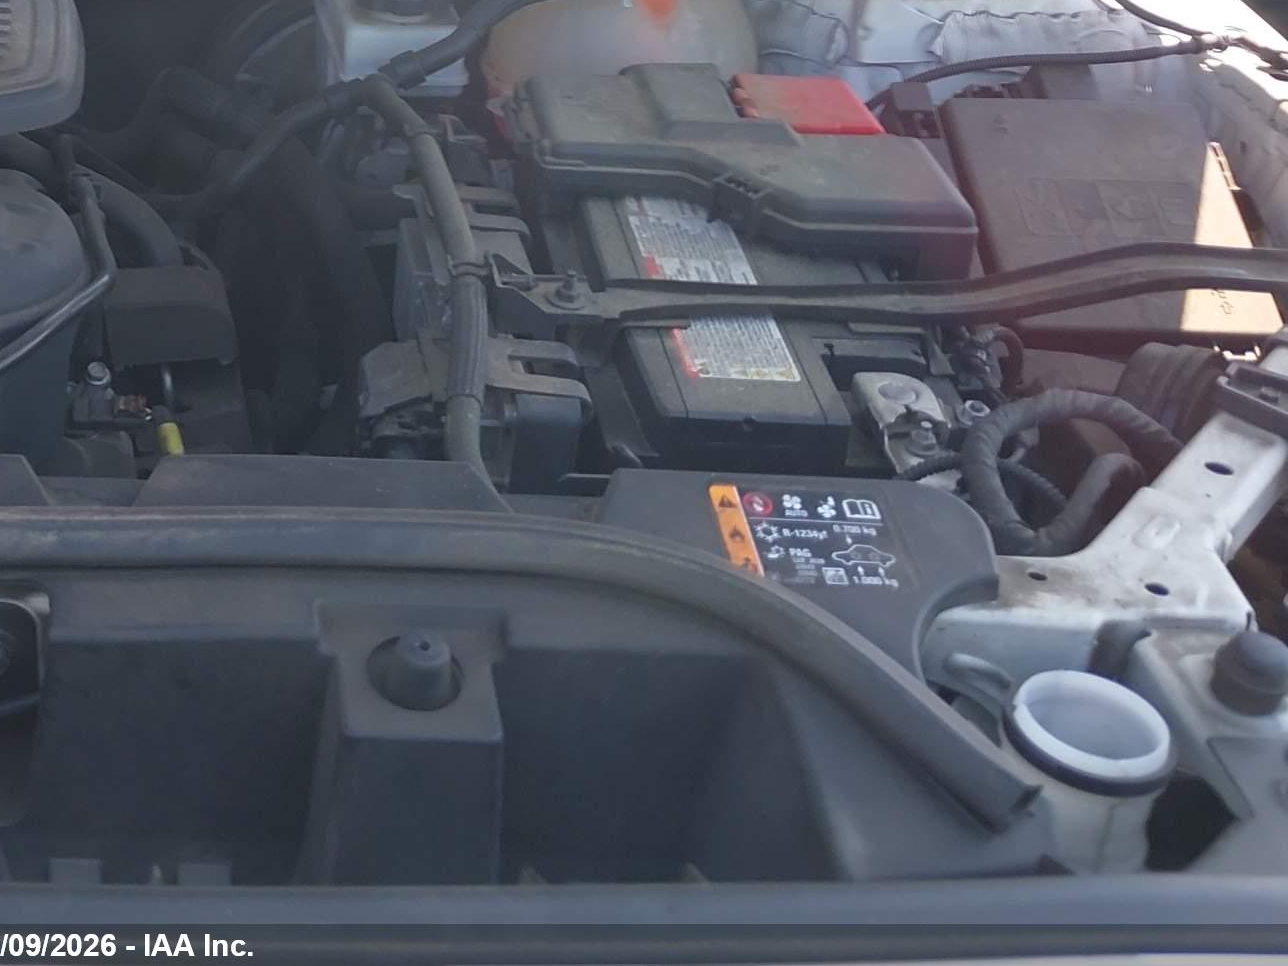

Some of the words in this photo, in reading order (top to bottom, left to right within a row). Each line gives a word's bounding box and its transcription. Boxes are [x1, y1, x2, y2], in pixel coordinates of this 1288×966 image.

[785, 509, 808, 517] AUTO
[782, 528, 828, 540] R-1234yf
[862, 526, 877, 536] kg
[789, 548, 812, 558] PAG
[883, 577, 899, 587] kg
